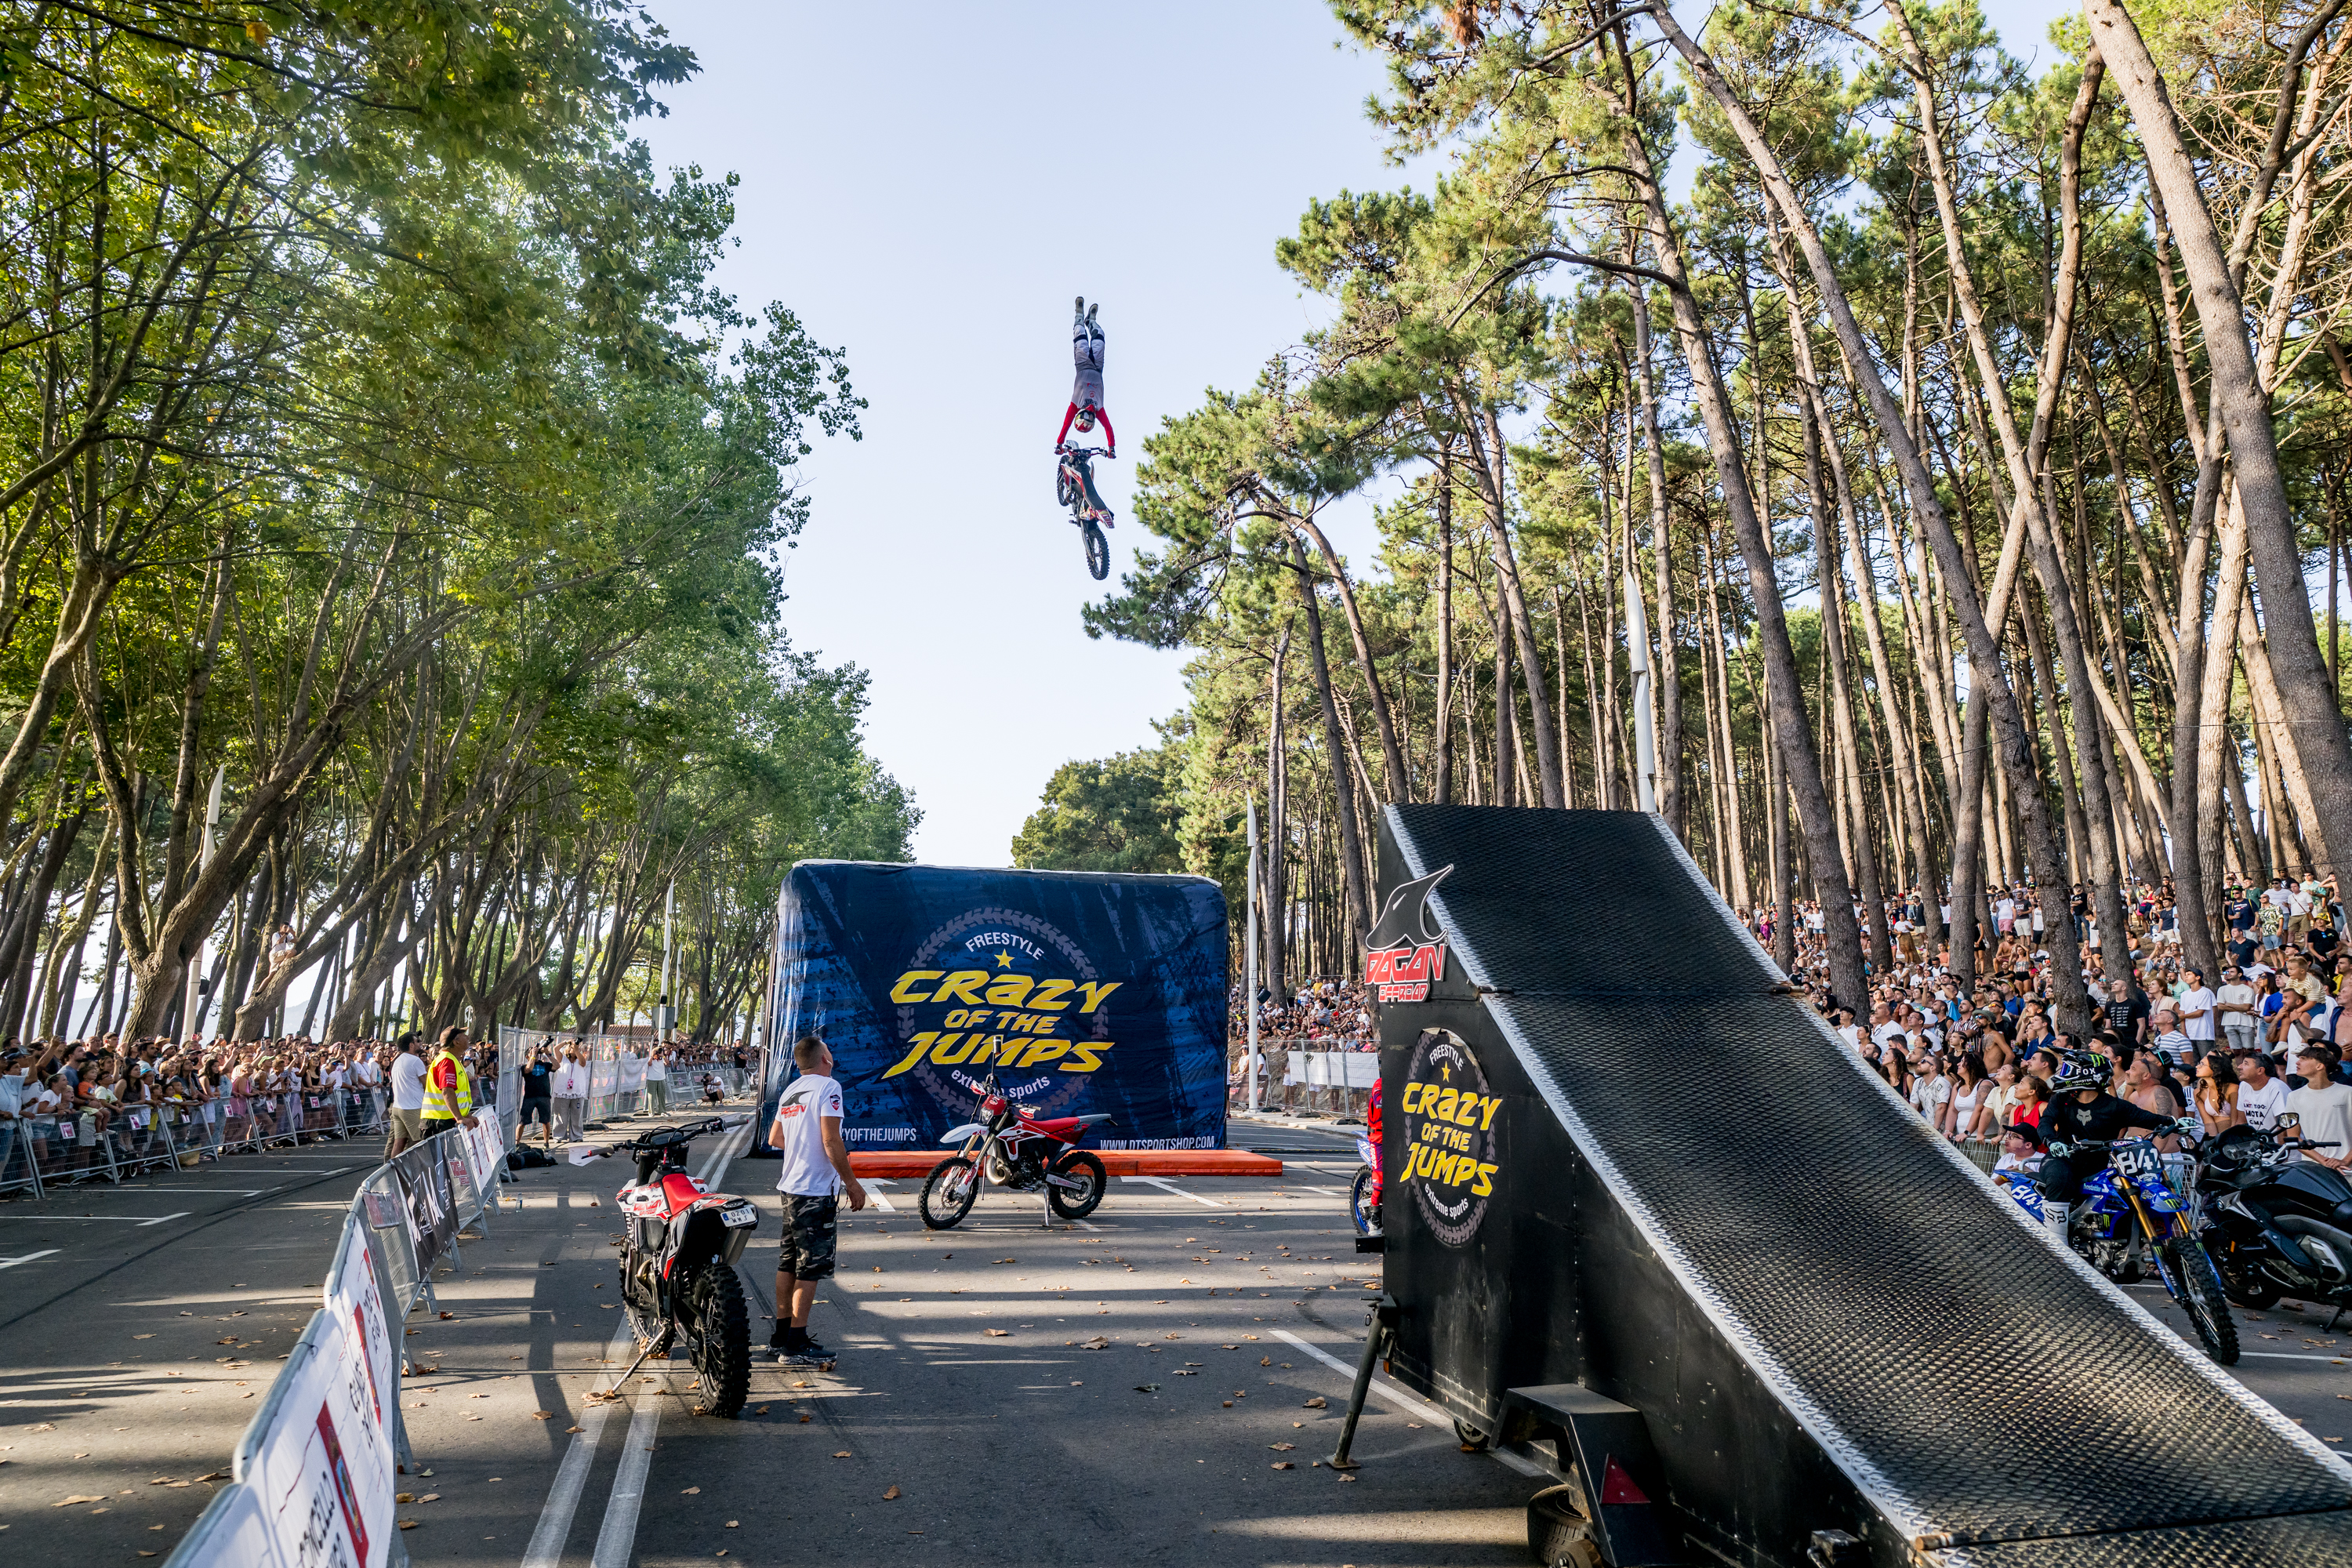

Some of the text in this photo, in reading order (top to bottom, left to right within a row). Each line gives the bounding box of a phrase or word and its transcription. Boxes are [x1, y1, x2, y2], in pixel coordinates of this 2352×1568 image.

[965, 932, 1044, 960] FREESTYLE
[1378, 983, 1428, 1002] OFFROAD
[944, 1009, 1061, 1034] OF THE
[881, 1032, 1115, 1080] JUMPS
[1429, 1044, 1464, 1071] FREESTYLE
[1009, 1074, 1051, 1100] sports
[842, 1127, 916, 1142] YOFTHEJUMPS
[1100, 1136, 1214, 1150] WWWDTSPORTSHOP.COM
[1421, 1123, 1472, 1152] OF THE
[1399, 1142, 1499, 1196] JUMPS
[2117, 1148, 2161, 1174] 841
[731, 1208, 750, 1218] 0201
[1425, 1183, 1468, 1220] extreme sports
